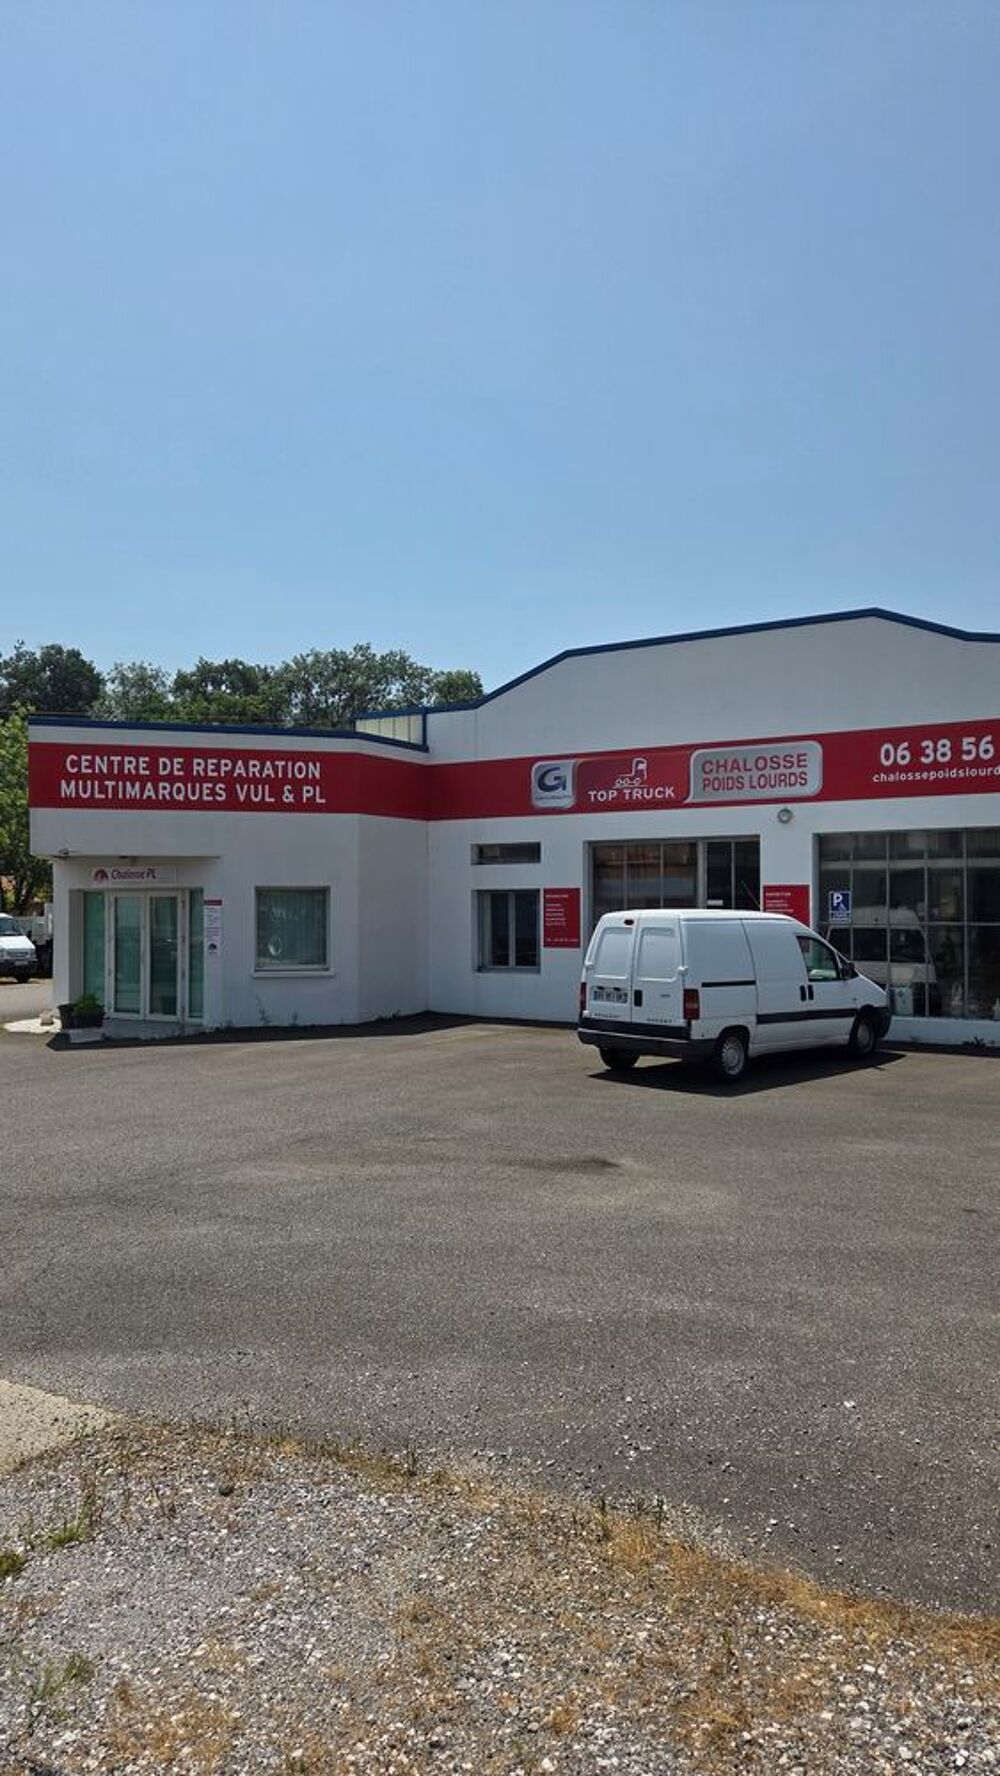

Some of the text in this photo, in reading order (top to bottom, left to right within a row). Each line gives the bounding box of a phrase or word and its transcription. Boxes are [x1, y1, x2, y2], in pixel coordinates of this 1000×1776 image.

[880, 734, 995, 767] 06 38 56
[65, 754, 322, 780] CENTRE DE REPARATION
[701, 752, 808, 775] CHALOSSE
[60, 779, 326, 804] MULTIMARQUES VUL & PL
[702, 771, 808, 793] POIDS LOURDS
[588, 790, 618, 803] TOP
[623, 785, 675, 801] TRUCK
[833, 892, 843, 907] P
